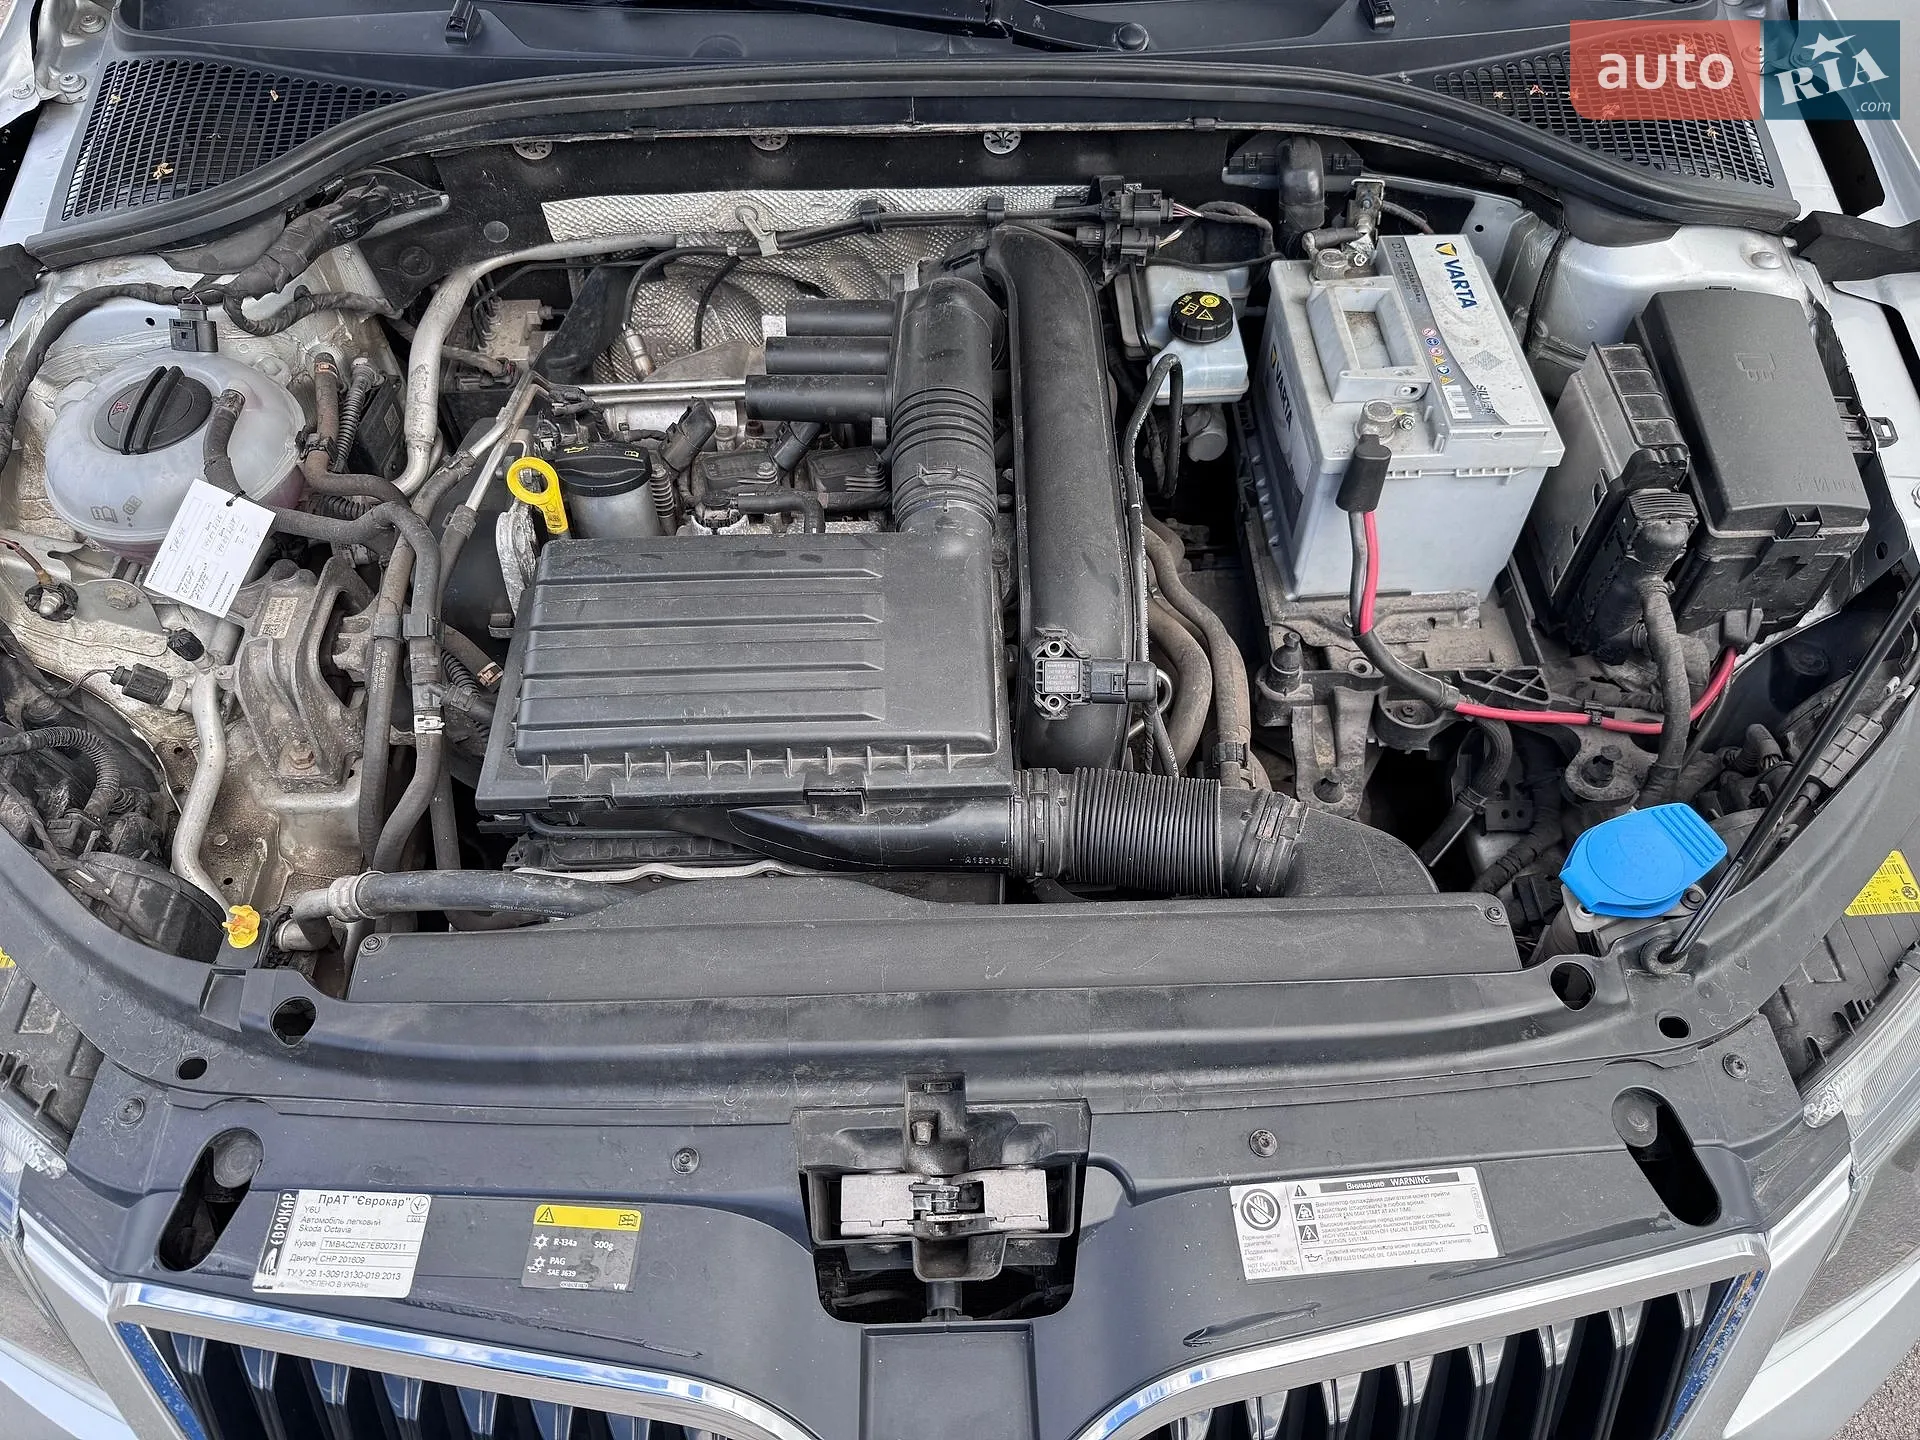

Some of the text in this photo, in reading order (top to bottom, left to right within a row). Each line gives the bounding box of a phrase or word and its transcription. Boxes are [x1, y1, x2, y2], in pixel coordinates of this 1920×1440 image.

[1444, 259, 1478, 309] VARTA
[1276, 364, 1292, 432] VARTA
[1346, 1176, 1430, 1190] Внимание WARNING
[318, 1194, 410, 1208] ПрАТ "Єврокар"
[270, 1192, 296, 1244] ЄВРОКАР
[300, 1216, 344, 1224] Автомобіль
[324, 1224, 352, 1233] Octavia
[554, 1238, 614, 1252] R-134a 500g
[550, 1257, 566, 1266] PAG
[613, 1282, 627, 1290] VW
